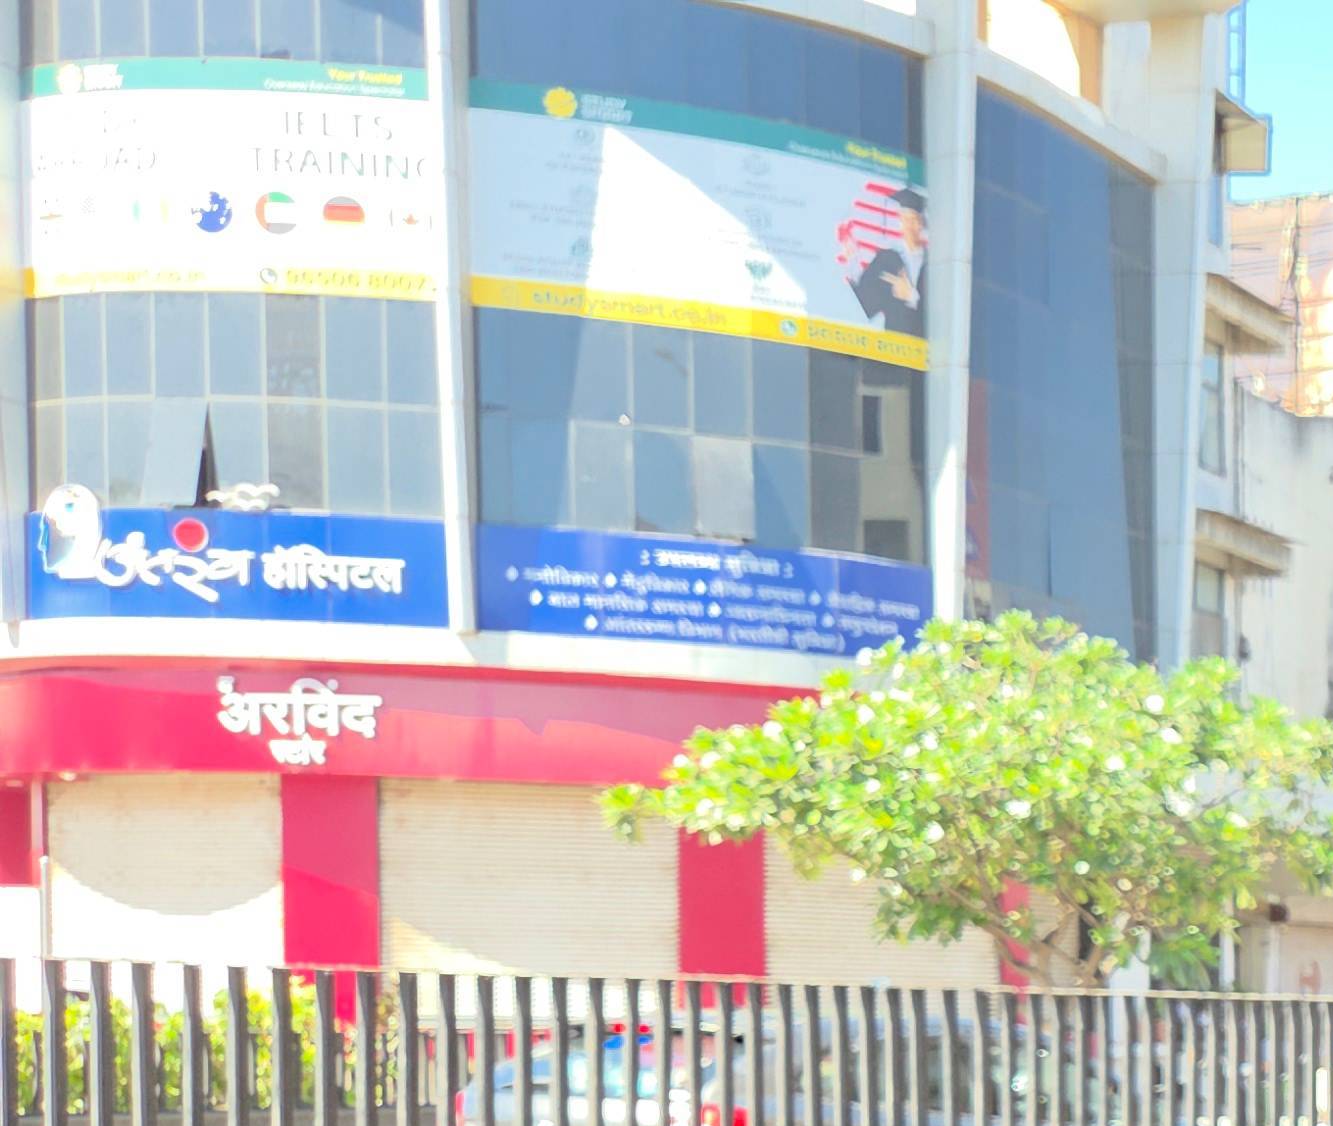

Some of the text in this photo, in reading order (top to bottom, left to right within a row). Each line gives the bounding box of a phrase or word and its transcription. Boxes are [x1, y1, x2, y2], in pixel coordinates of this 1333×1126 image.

[285, 111, 393, 141] IELTS
[260, 543, 406, 595] हॉस्पिटल
[217, 676, 383, 739] अरविंद
